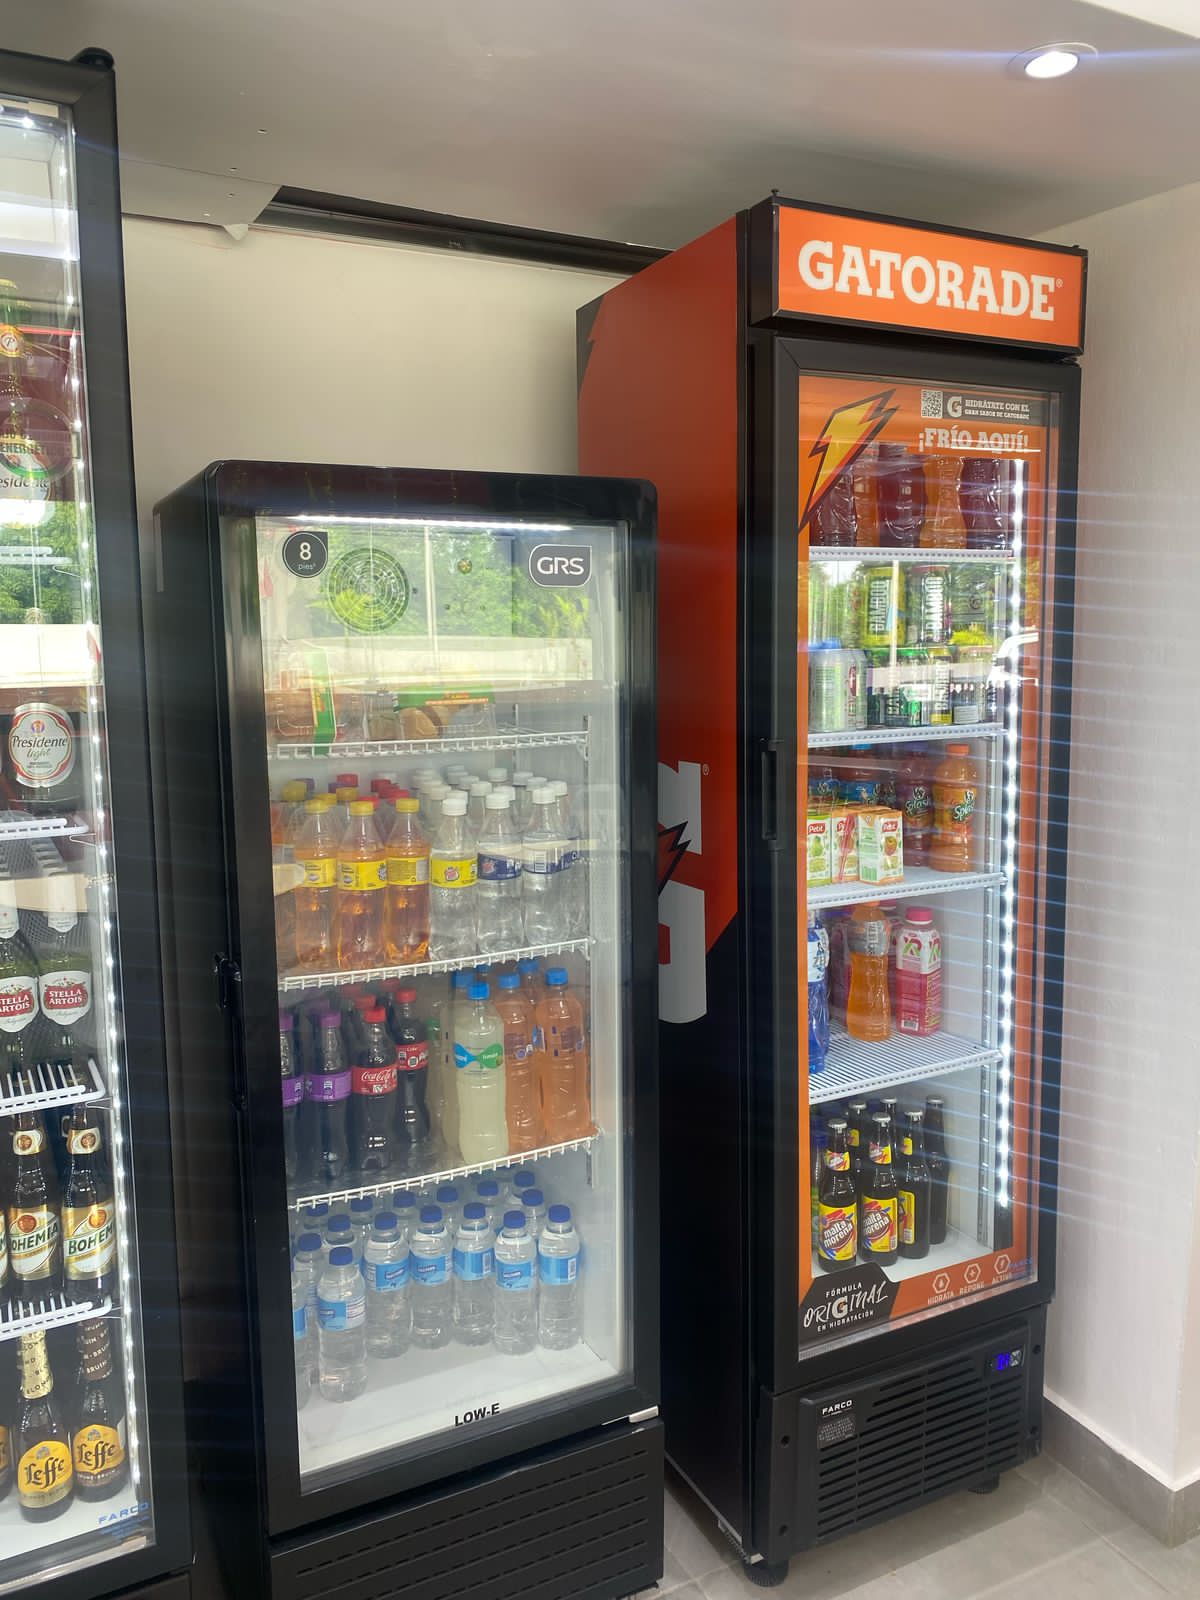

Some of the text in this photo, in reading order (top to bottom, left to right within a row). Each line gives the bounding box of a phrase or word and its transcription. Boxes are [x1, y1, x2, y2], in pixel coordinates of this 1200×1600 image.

[798, 239, 1056, 321] GATORADE
[299, 542, 312, 561] 8
[537, 556, 584, 575] GRS
[49, 988, 82, 998] STELLA
[823, 1223, 853, 1248] morena
[824, 1220, 847, 1239] malta
[825, 1282, 862, 1298] FÓRMULA
[927, 1290, 955, 1305] HIDRATA
[803, 1280, 889, 1328] ORIGINAL
[455, 1402, 500, 1427] LOW-E
[822, 1399, 852, 1415] FARCO
[77, 1440, 116, 1470] Leffe
[24, 1457, 65, 1489] Leffe
